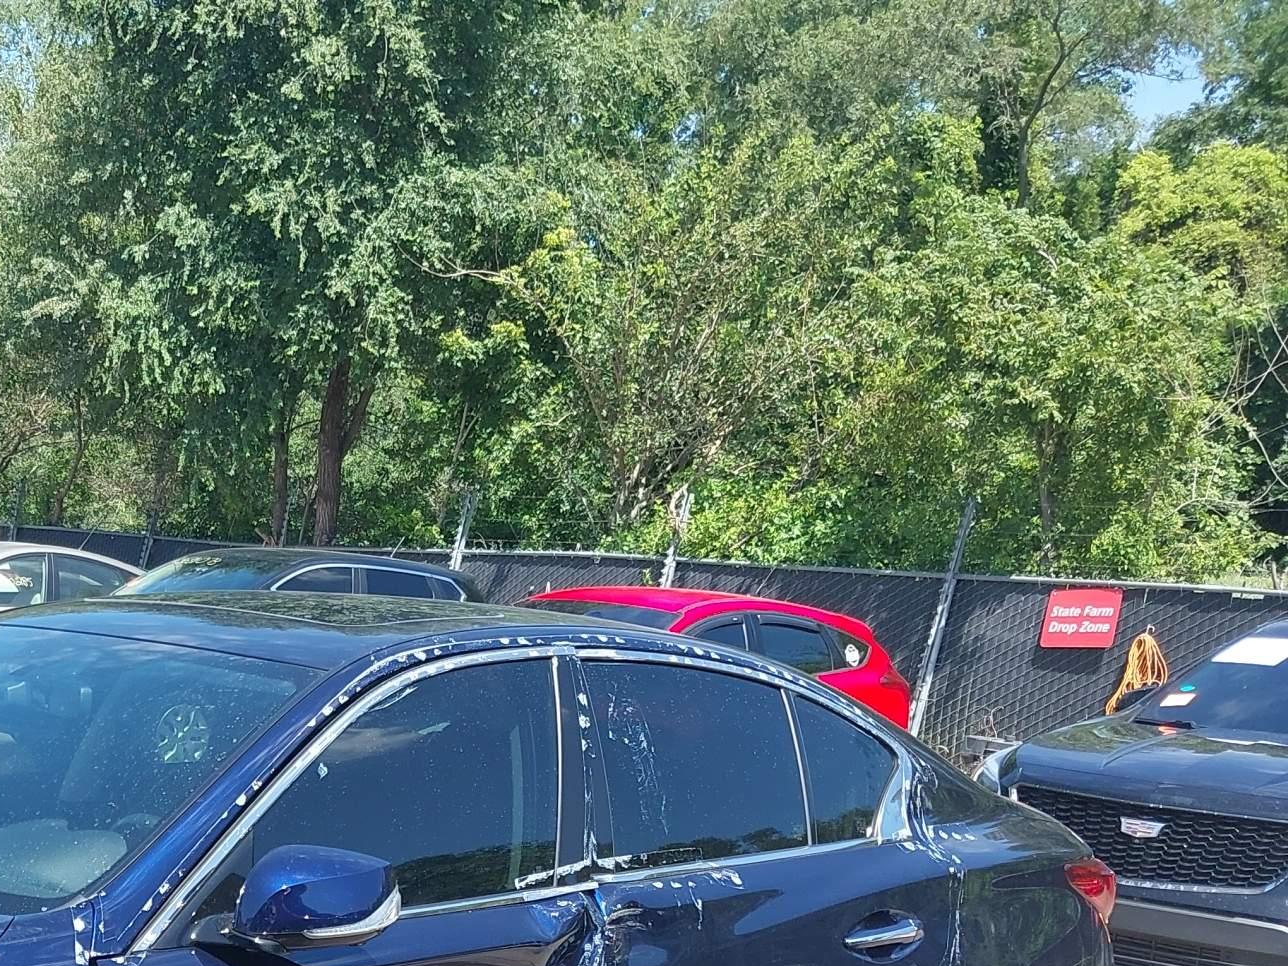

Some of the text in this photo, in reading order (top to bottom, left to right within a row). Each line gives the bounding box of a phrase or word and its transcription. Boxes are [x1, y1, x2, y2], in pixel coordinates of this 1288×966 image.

[1051, 606, 1114, 617] State Farm
[1048, 621, 1110, 635] Drop Zone
